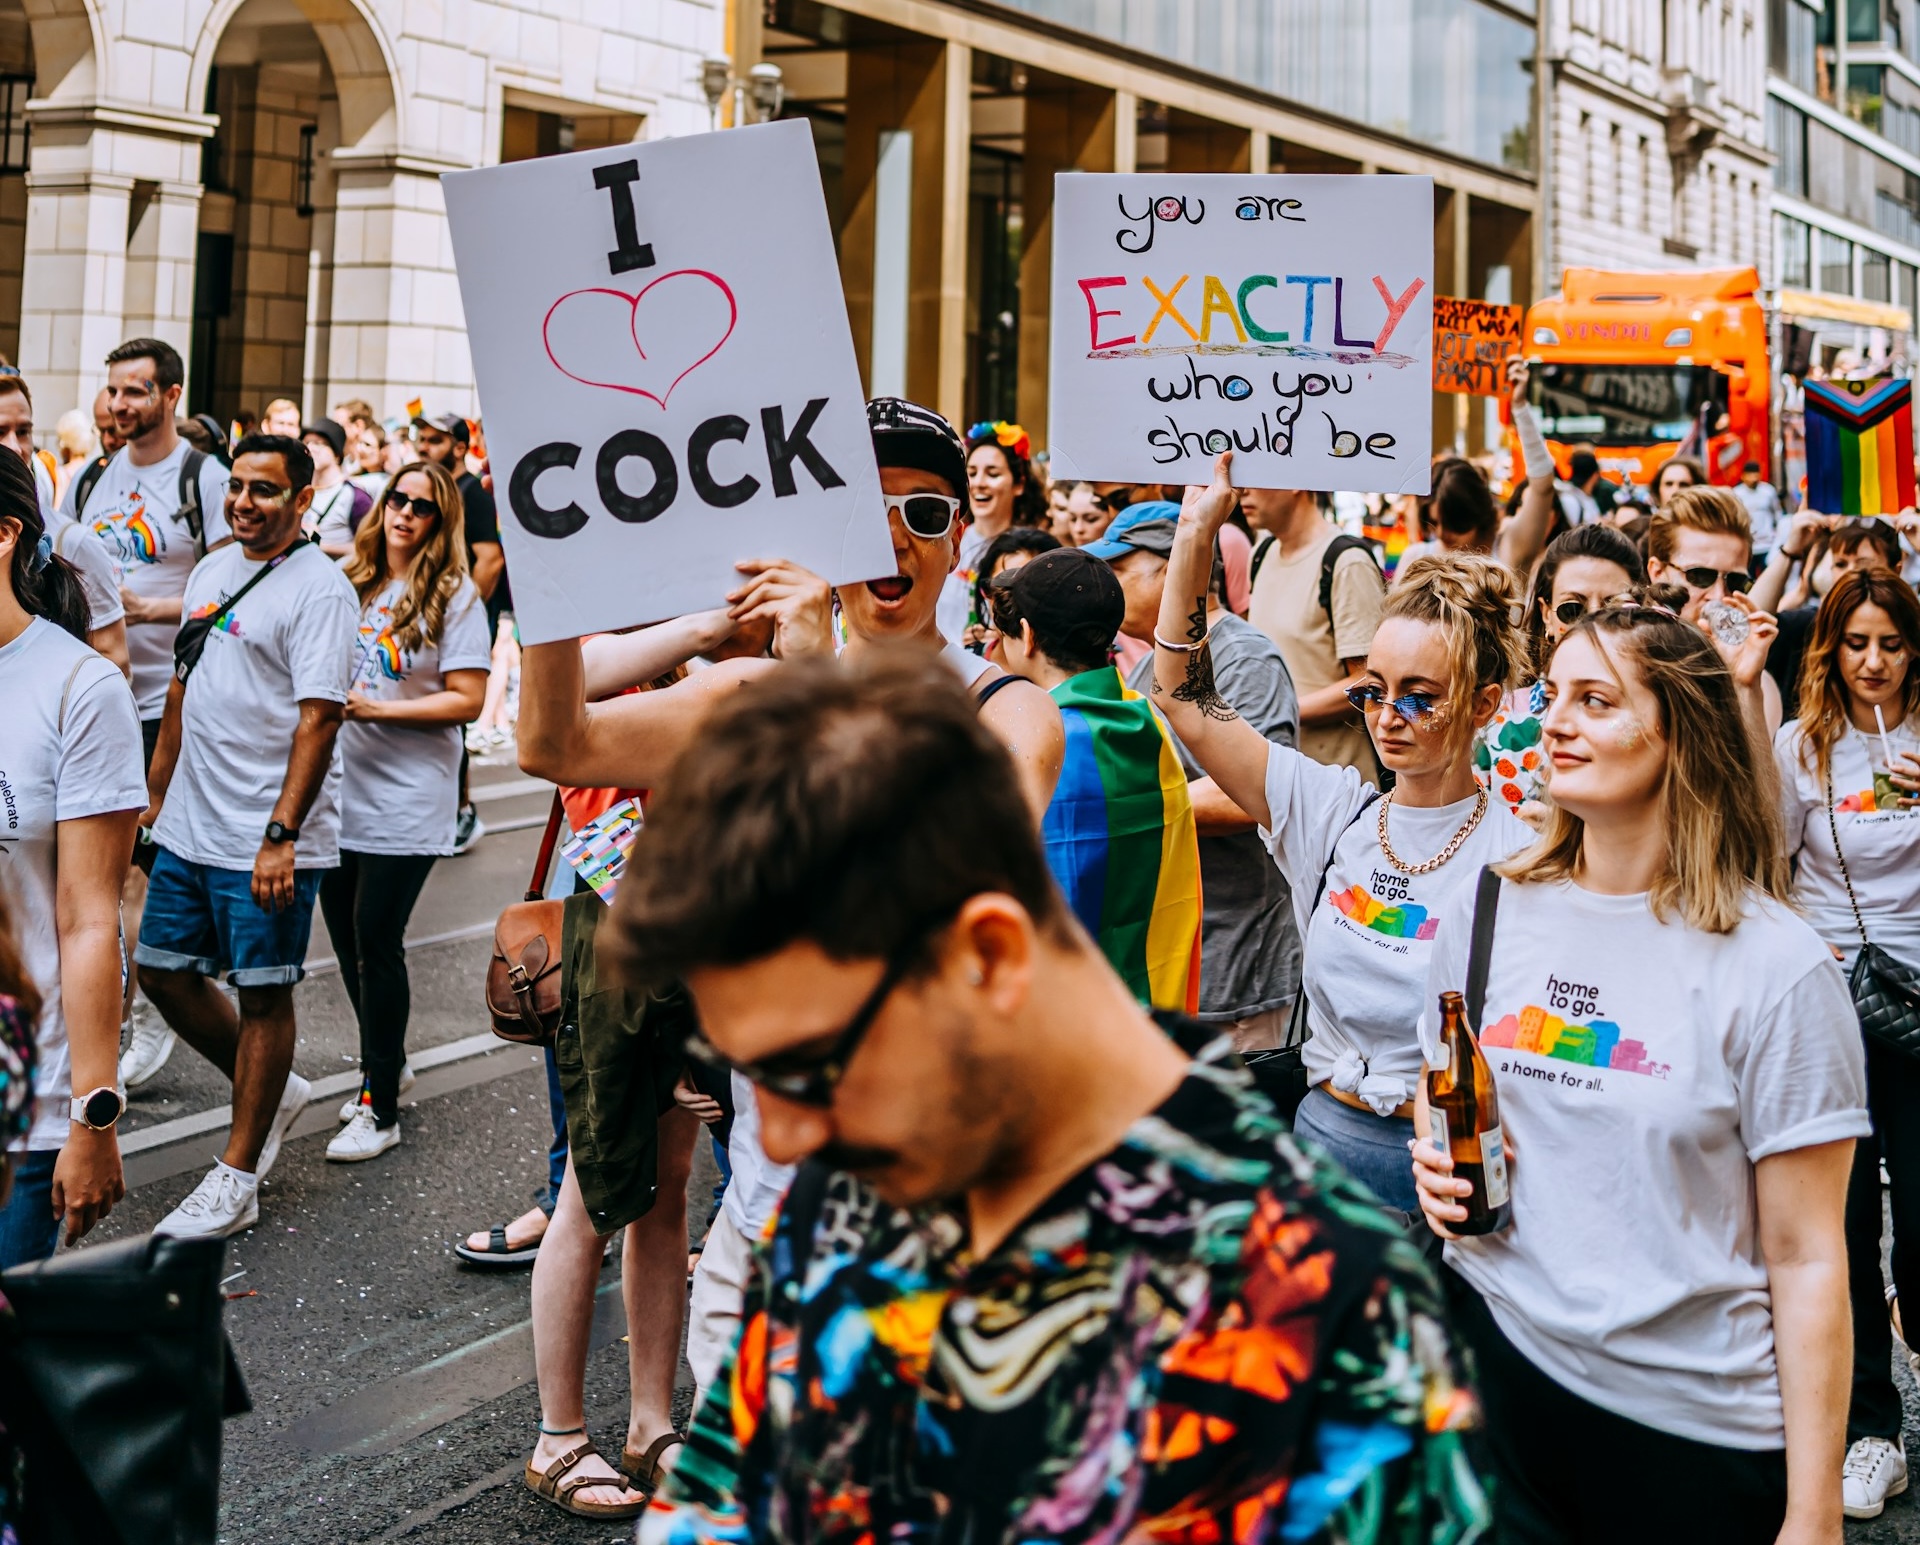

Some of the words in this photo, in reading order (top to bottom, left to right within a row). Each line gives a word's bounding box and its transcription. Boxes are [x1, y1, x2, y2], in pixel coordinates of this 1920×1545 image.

[592, 159, 656, 275] I
[1116, 193, 1205, 253] you
[1235, 195, 1307, 222] are
[1078, 274, 1426, 355] EXACTLY
[1477, 319, 1505, 337] WAS
[1509, 320, 1520, 336] A
[1475, 341, 1512, 362] NOT
[1148, 354, 1253, 402] who
[1273, 370, 1353, 425] you
[1148, 412, 1294, 464] should
[1322, 410, 1396, 460] be
[508, 397, 847, 539] COCK
[1370, 867, 1410, 888] home
[1372, 882, 1386, 896] to
[1374, 940, 1391, 950] for
[1392, 945, 1409, 955] all.
[1546, 973, 1599, 999] home
[1550, 992, 1568, 1009] to
[1500, 1061, 1509, 1072] a
[1512, 1060, 1556, 1082] home
[1560, 1072, 1583, 1088] for
[1585, 1077, 1604, 1092] all.
